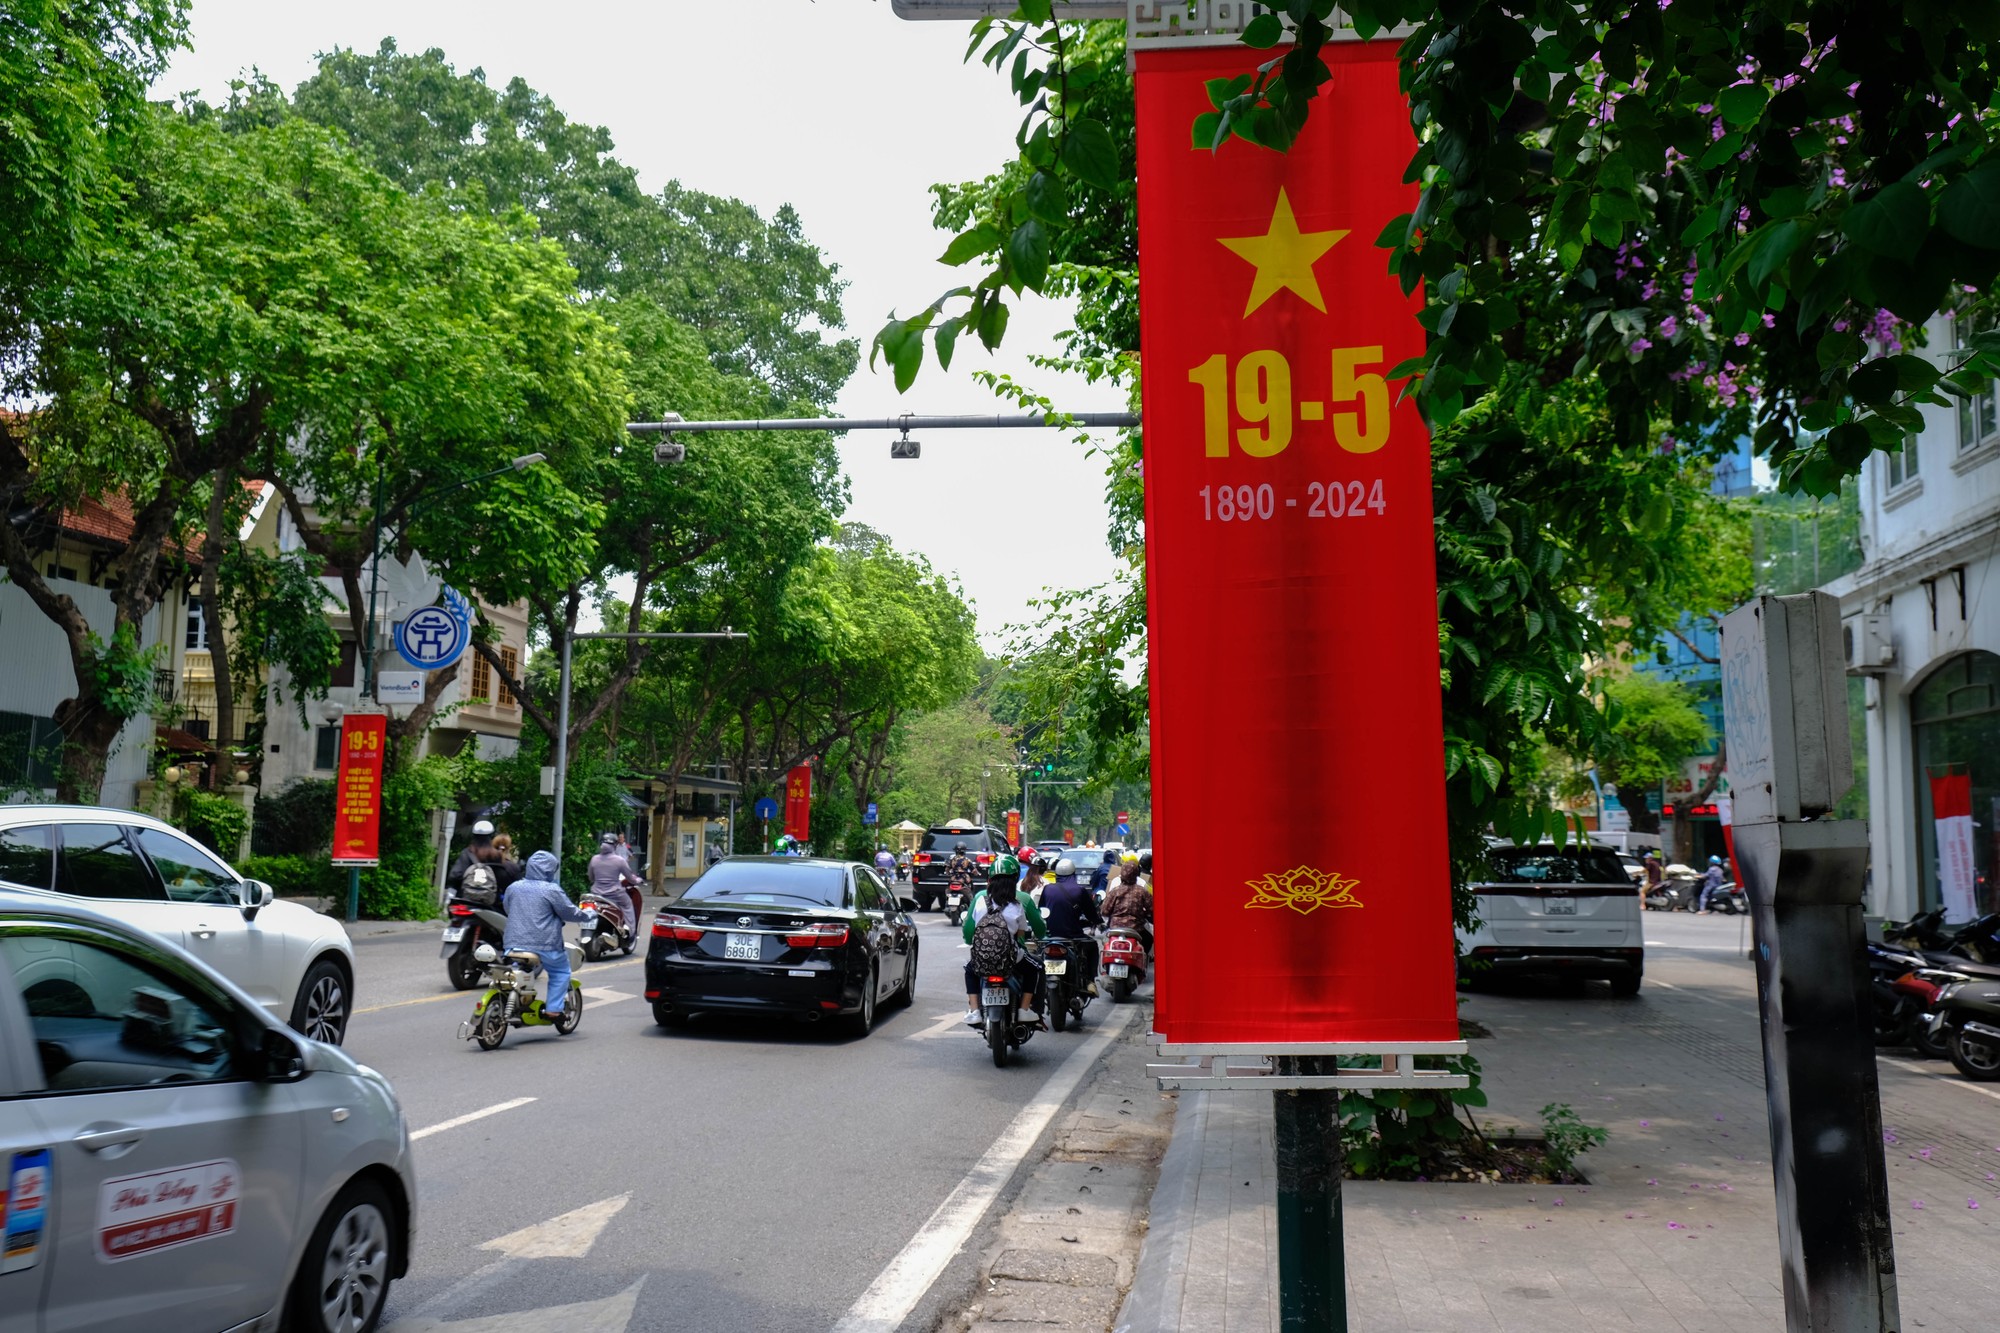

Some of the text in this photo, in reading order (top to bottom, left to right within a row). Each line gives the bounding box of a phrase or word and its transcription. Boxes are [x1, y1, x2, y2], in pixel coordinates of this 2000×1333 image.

[1188, 345, 1391, 458] 19-5
[1199, 483, 1275, 521] 1890
[1307, 479, 1387, 518] 2024
[347, 731, 378, 750] 19-5
[790, 788, 805, 798] 19-5
[734, 934, 753, 946] 30E
[726, 946, 759, 959] 689.03
[986, 988, 1006, 996] 29-F1
